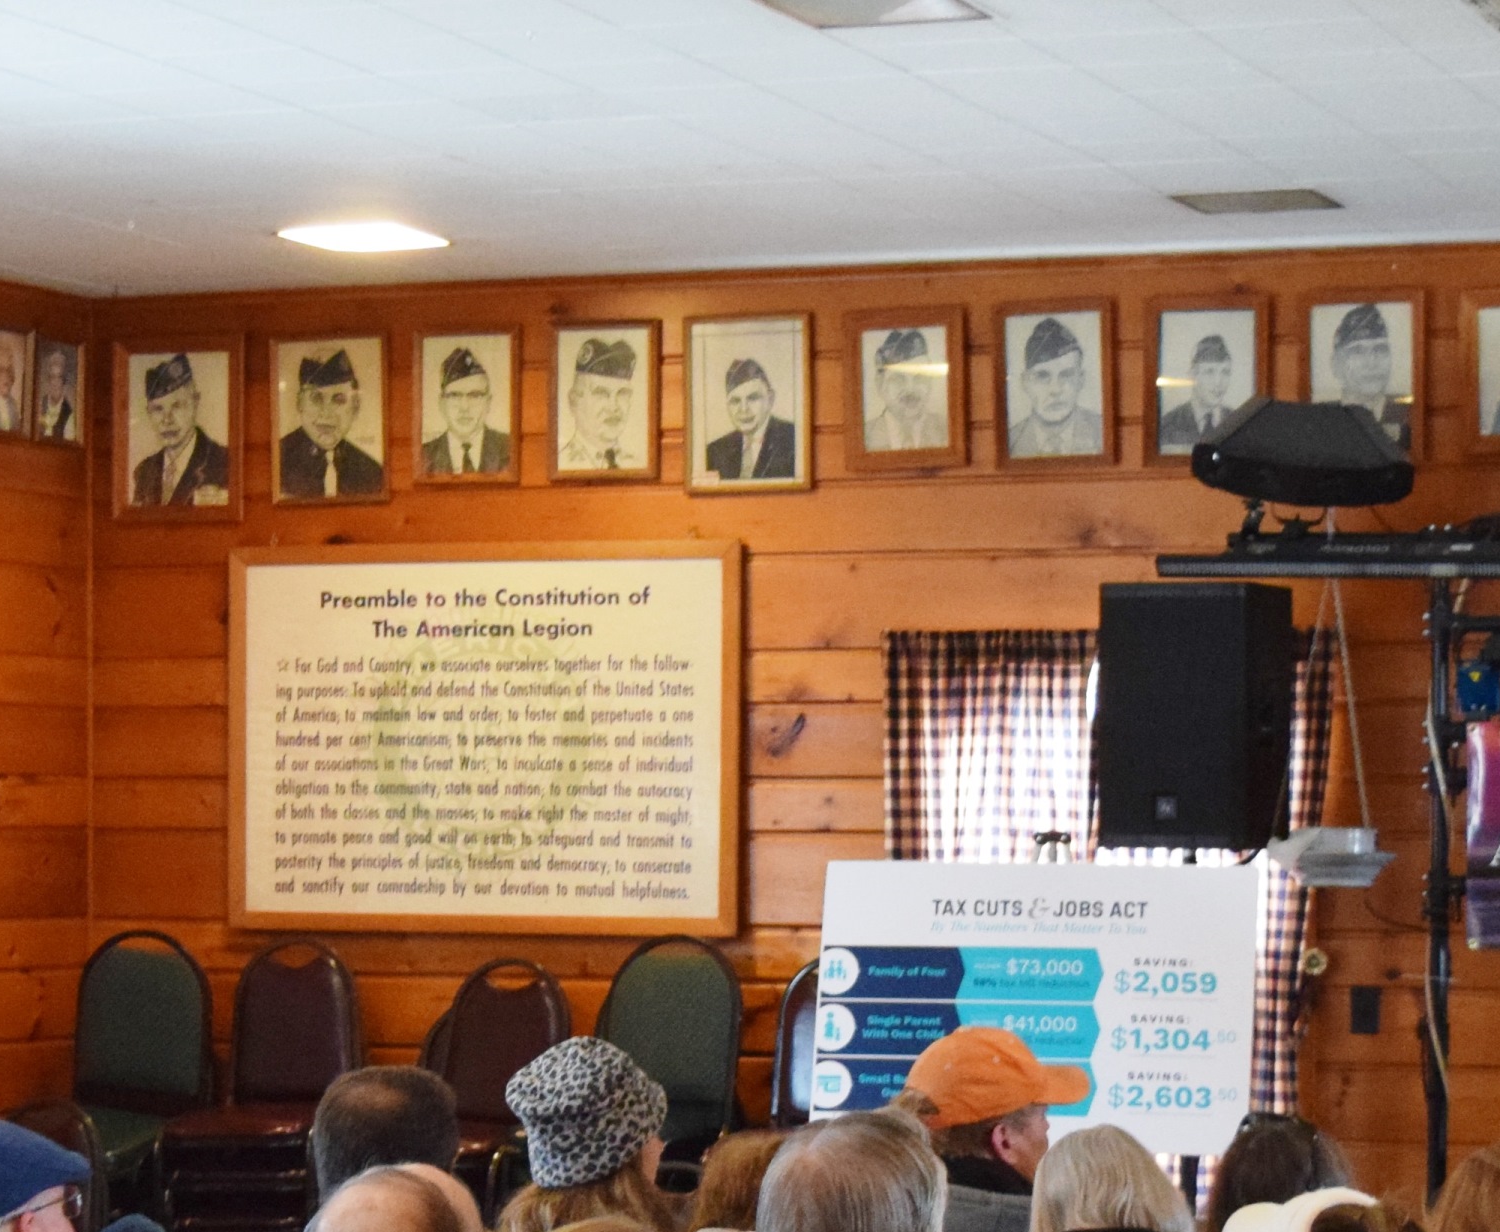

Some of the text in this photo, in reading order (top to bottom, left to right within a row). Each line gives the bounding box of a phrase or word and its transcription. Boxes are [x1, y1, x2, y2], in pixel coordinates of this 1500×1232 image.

[321, 585, 650, 608] Preamble to the Constitution of
[372, 618, 592, 640] The American Legion
[295, 657, 311, 673] For
[317, 657, 338, 673] God
[343, 657, 363, 673] and
[421, 660, 436, 671] we
[441, 657, 490, 672] associate
[496, 655, 548, 672] ourselves
[554, 655, 602, 675] together
[607, 654, 623, 671] for
[630, 654, 648, 671] the
[276, 683, 292, 700] ing
[353, 682, 364, 697] To
[370, 681, 407, 700] uphold
[411, 682, 432, 697] and
[437, 682, 474, 697] defend
[481, 682, 498, 697] the
[503, 681, 571, 697] Constitution
[576, 680, 589, 696] of
[592, 681, 610, 696] the
[616, 681, 653, 696] United
[659, 680, 694, 696] States
[276, 707, 287, 722] of
[345, 708, 356, 722] to
[363, 707, 411, 722] maintain
[417, 706, 436, 721] law
[443, 706, 463, 722] and
[508, 708, 519, 722] to
[525, 705, 557, 722] foster
[563, 705, 585, 722] and
[591, 708, 653, 725] perpetuate
[659, 710, 666, 722] a
[673, 710, 694, 722] one
[275, 731, 320, 747] hundred
[326, 735, 343, 750] per
[349, 734, 372, 747] cent
[457, 732, 468, 747] to
[474, 734, 522, 749] preserve
[528, 731, 546, 747] the
[552, 732, 608, 747] memories
[614, 730, 635, 747] and
[642, 730, 694, 747] incidents
[275, 754, 286, 771] of
[291, 758, 309, 771] our
[314, 756, 378, 771] associations
[384, 757, 395, 771] in
[400, 754, 418, 771] the
[423, 755, 453, 771] Great
[497, 757, 508, 771] to
[513, 754, 563, 771] inculcate
[568, 759, 576, 771] a
[583, 758, 613, 772] sense
[619, 754, 631, 772] of
[636, 755, 693, 773] individual
[275, 779, 329, 799] obligation
[335, 782, 346, 795] to
[351, 779, 369, 795] the
[444, 781, 472, 795] state
[477, 779, 499, 795] and
[549, 782, 561, 796] to
[566, 781, 608, 796] combat
[614, 780, 631, 796] the
[637, 782, 693, 801] autocracy
[275, 802, 286, 820] of
[291, 803, 315, 820] both
[320, 803, 338, 820] the
[343, 803, 379, 820] classes
[385, 803, 406, 820] and
[412, 803, 430, 820] the
[483, 806, 495, 820] to
[500, 805, 531, 821] make
[537, 805, 564, 824] right
[570, 804, 588, 821] the
[593, 807, 632, 822] master
[638, 804, 650, 822] of
[932, 897, 1148, 920] TAX CUTS & JOBS ACT
[868, 966, 946, 979] Family of Four
[1005, 958, 1083, 977] $73,000
[1114, 969, 1217, 996] $2,059
[867, 1015, 941, 1027] Single Parent
[1003, 1015, 1076, 1034] $41,000
[862, 1028, 945, 1040] With One Child
